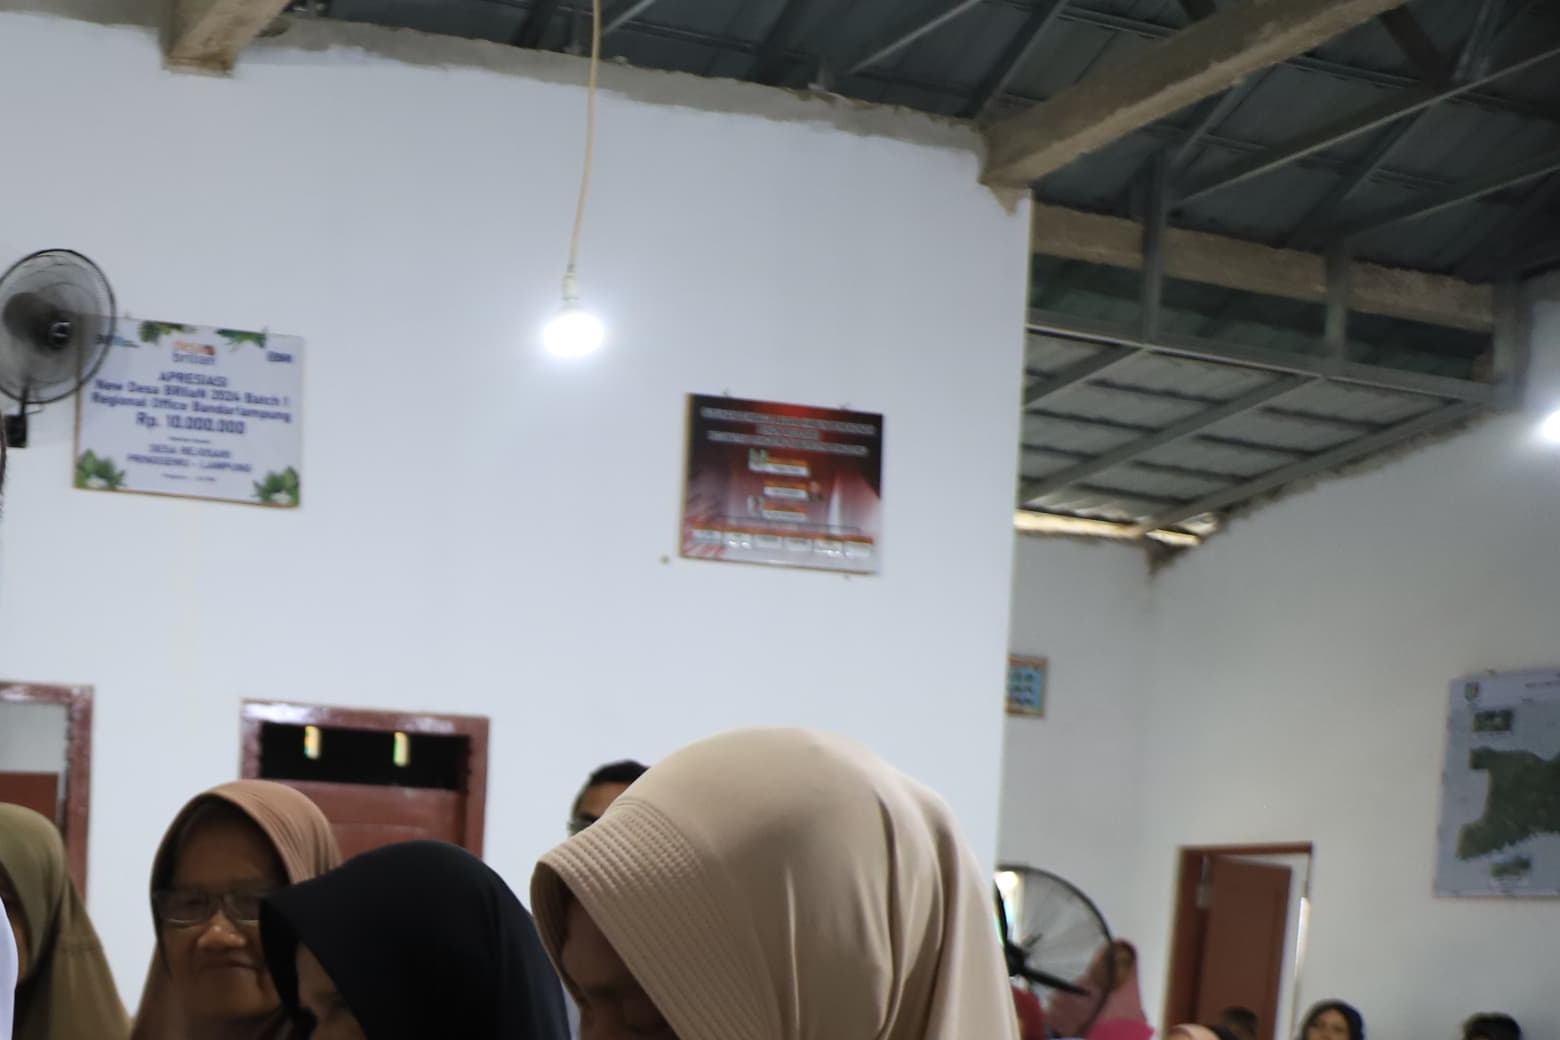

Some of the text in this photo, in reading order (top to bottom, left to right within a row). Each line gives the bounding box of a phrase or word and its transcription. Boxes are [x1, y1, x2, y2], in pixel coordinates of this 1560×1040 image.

[128, 381, 159, 394] Desa
[158, 371, 228, 387] APRESIASI
[92, 392, 147, 407] Regional
[152, 397, 188, 410] Office
[136, 412, 246, 434] Rp. 10.000.000
